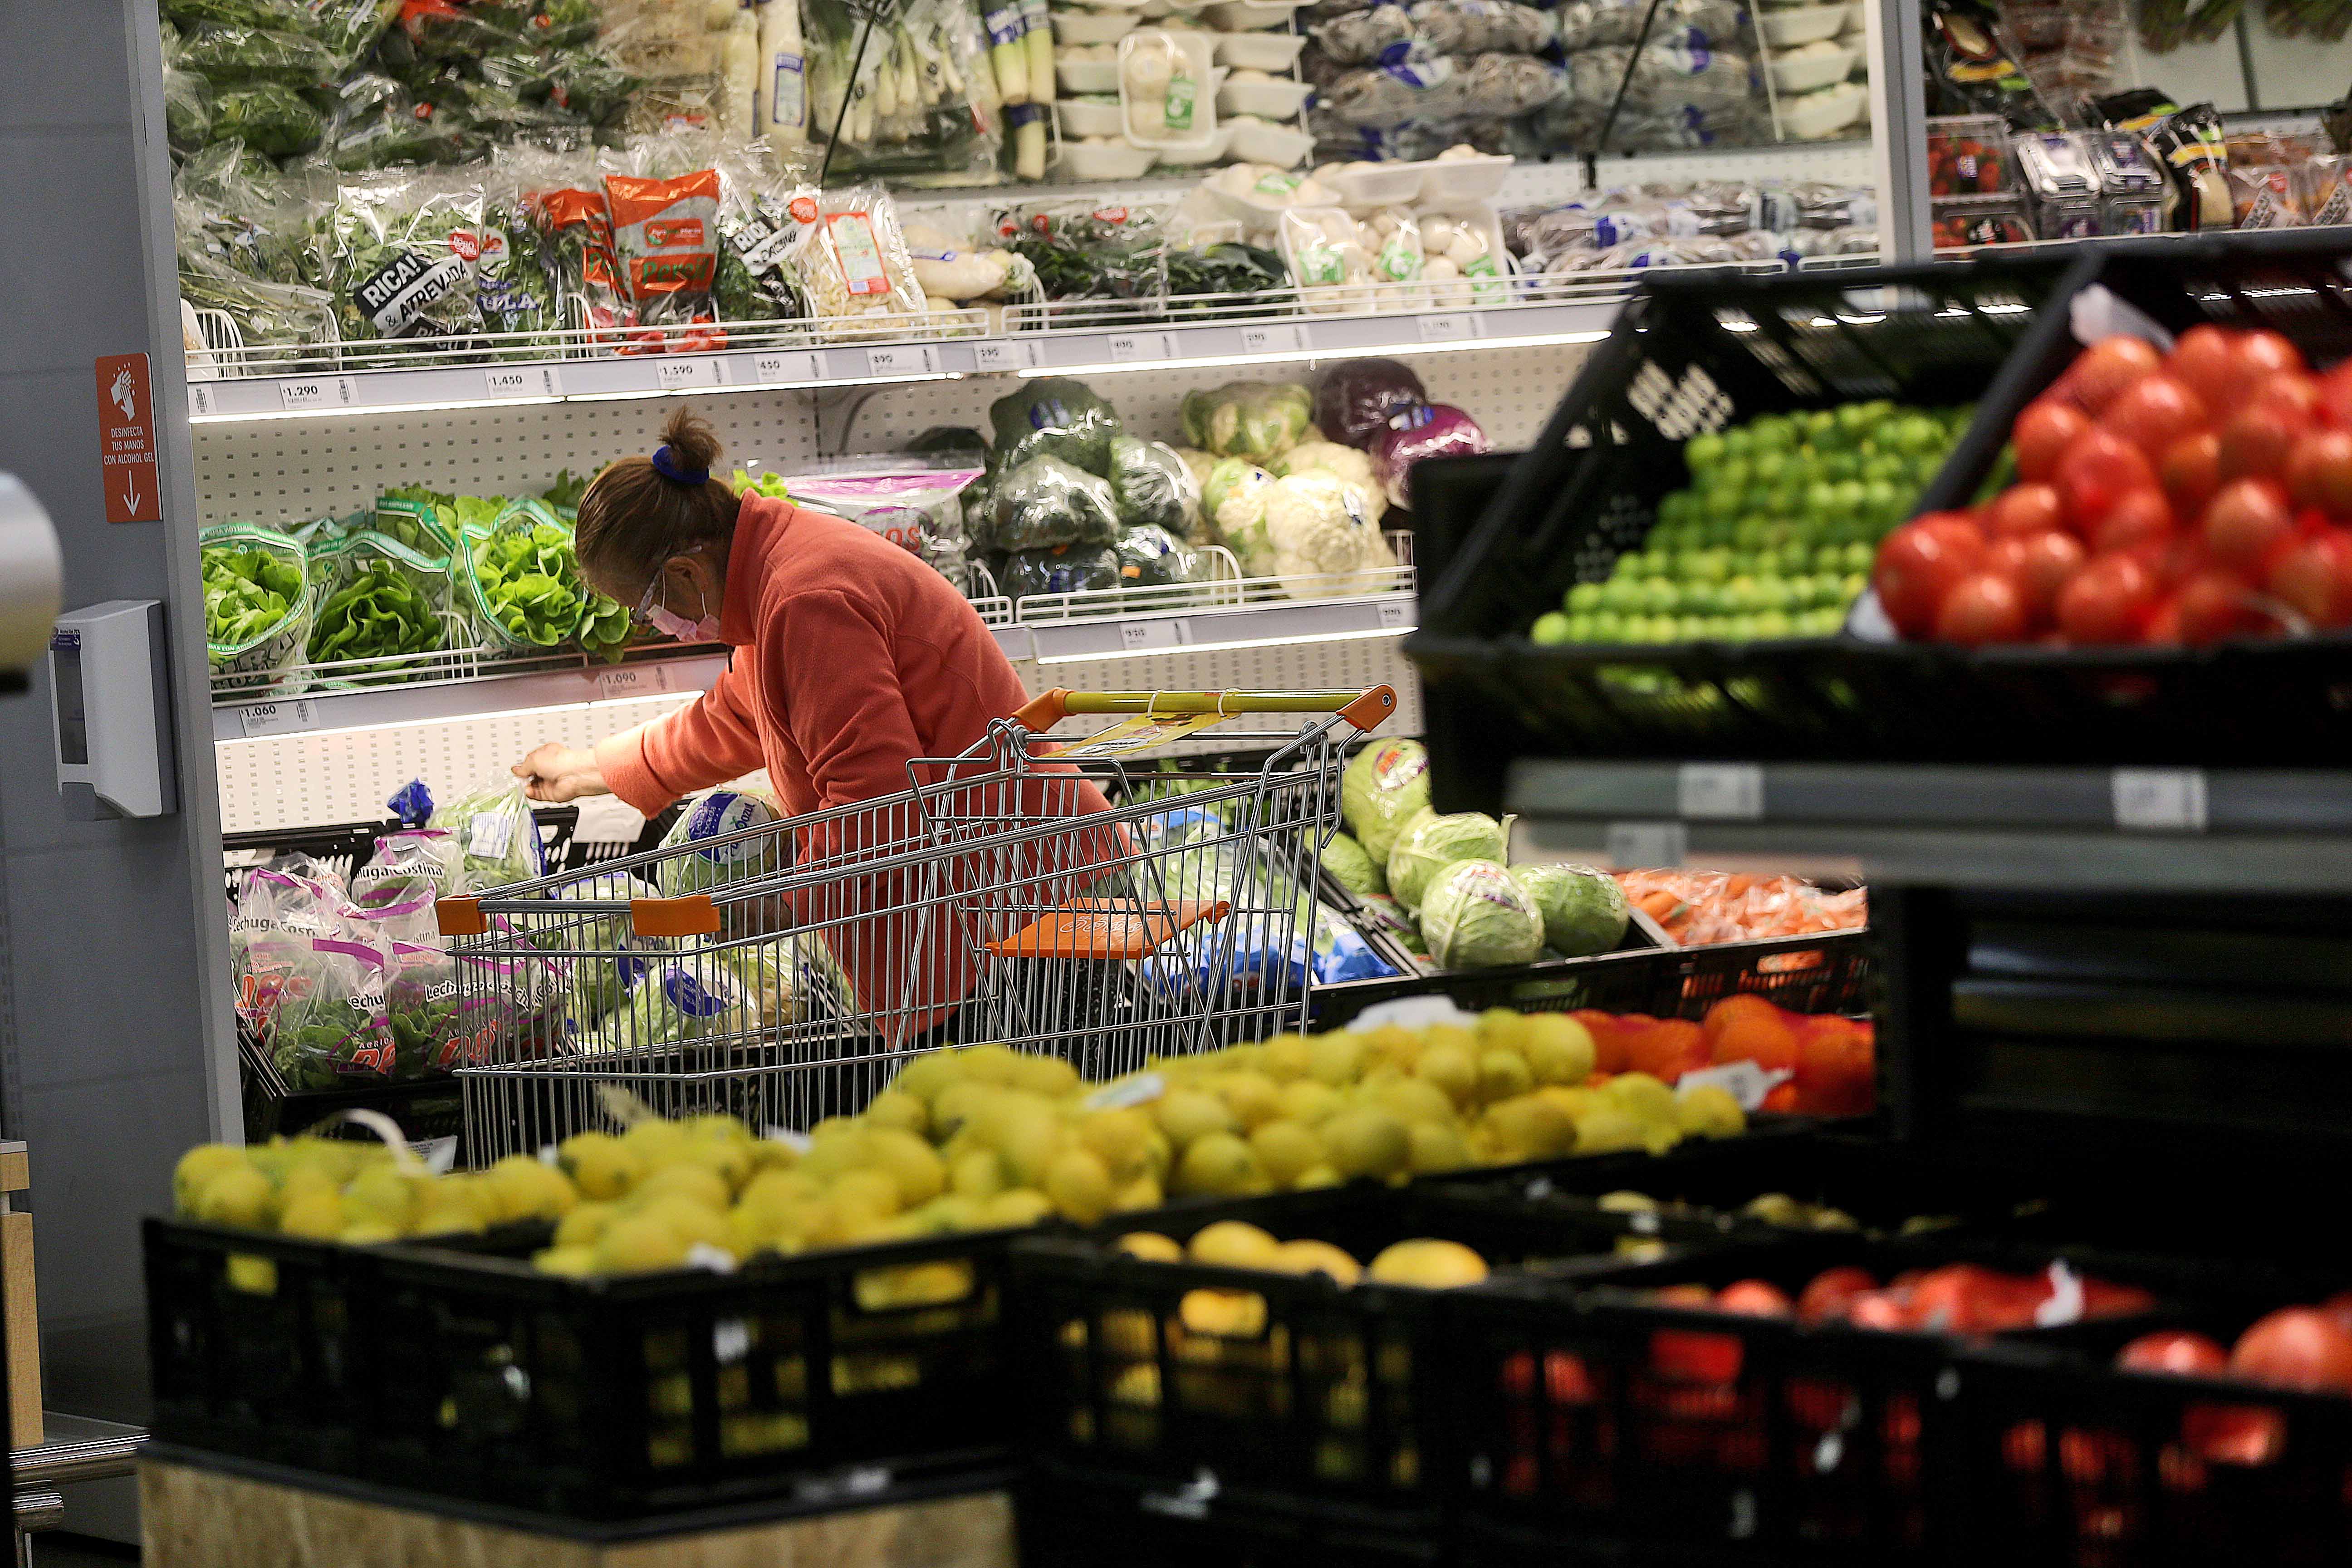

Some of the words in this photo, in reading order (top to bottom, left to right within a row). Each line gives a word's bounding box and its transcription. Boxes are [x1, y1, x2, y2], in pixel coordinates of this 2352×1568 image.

[362, 254, 421, 309] RICA!
[111, 426, 143, 438] DESINFECTA
[112, 441, 122, 451] TUS
[124, 439, 144, 450] MANOS
[104, 454, 116, 465] CON
[118, 453, 142, 464] ALCOHOL
[144, 452, 154, 462] GEL
